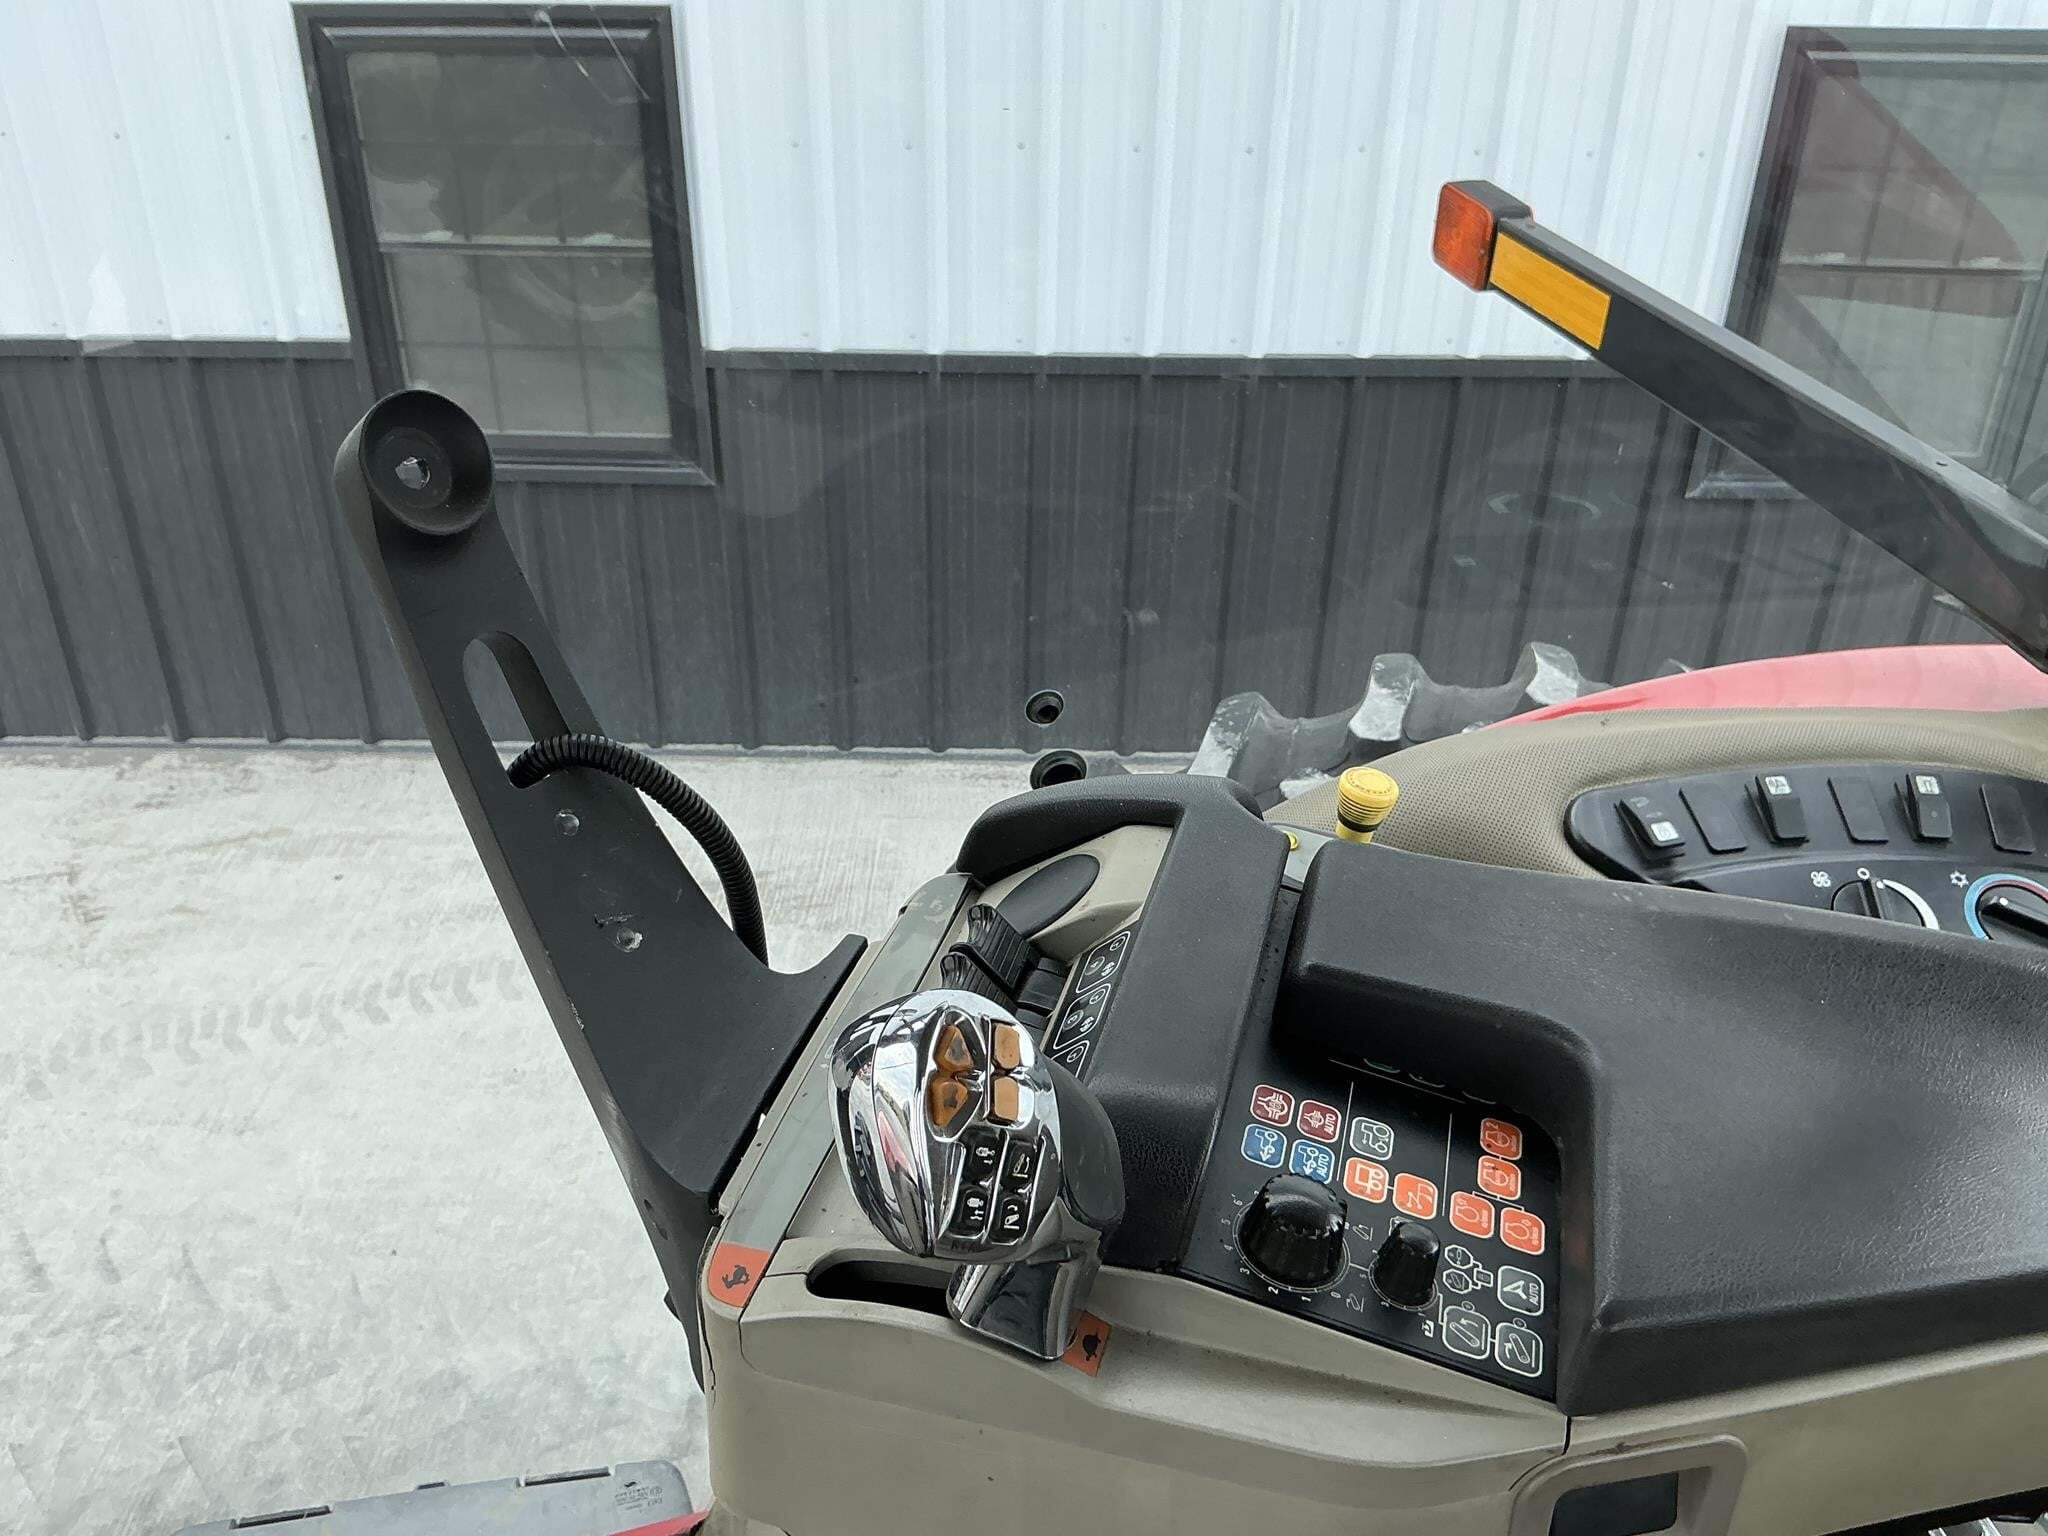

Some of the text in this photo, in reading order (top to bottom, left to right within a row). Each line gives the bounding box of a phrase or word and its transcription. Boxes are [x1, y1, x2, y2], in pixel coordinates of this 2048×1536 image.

[1324, 1113, 1336, 1135] AUTO
[1317, 1154, 1330, 1178] AUTO
[1221, 1218, 1231, 1226] 5
[1239, 1267, 1250, 1275] 3
[1268, 1286, 1279, 1295] 2
[1529, 1283, 1539, 1305] AUTO
